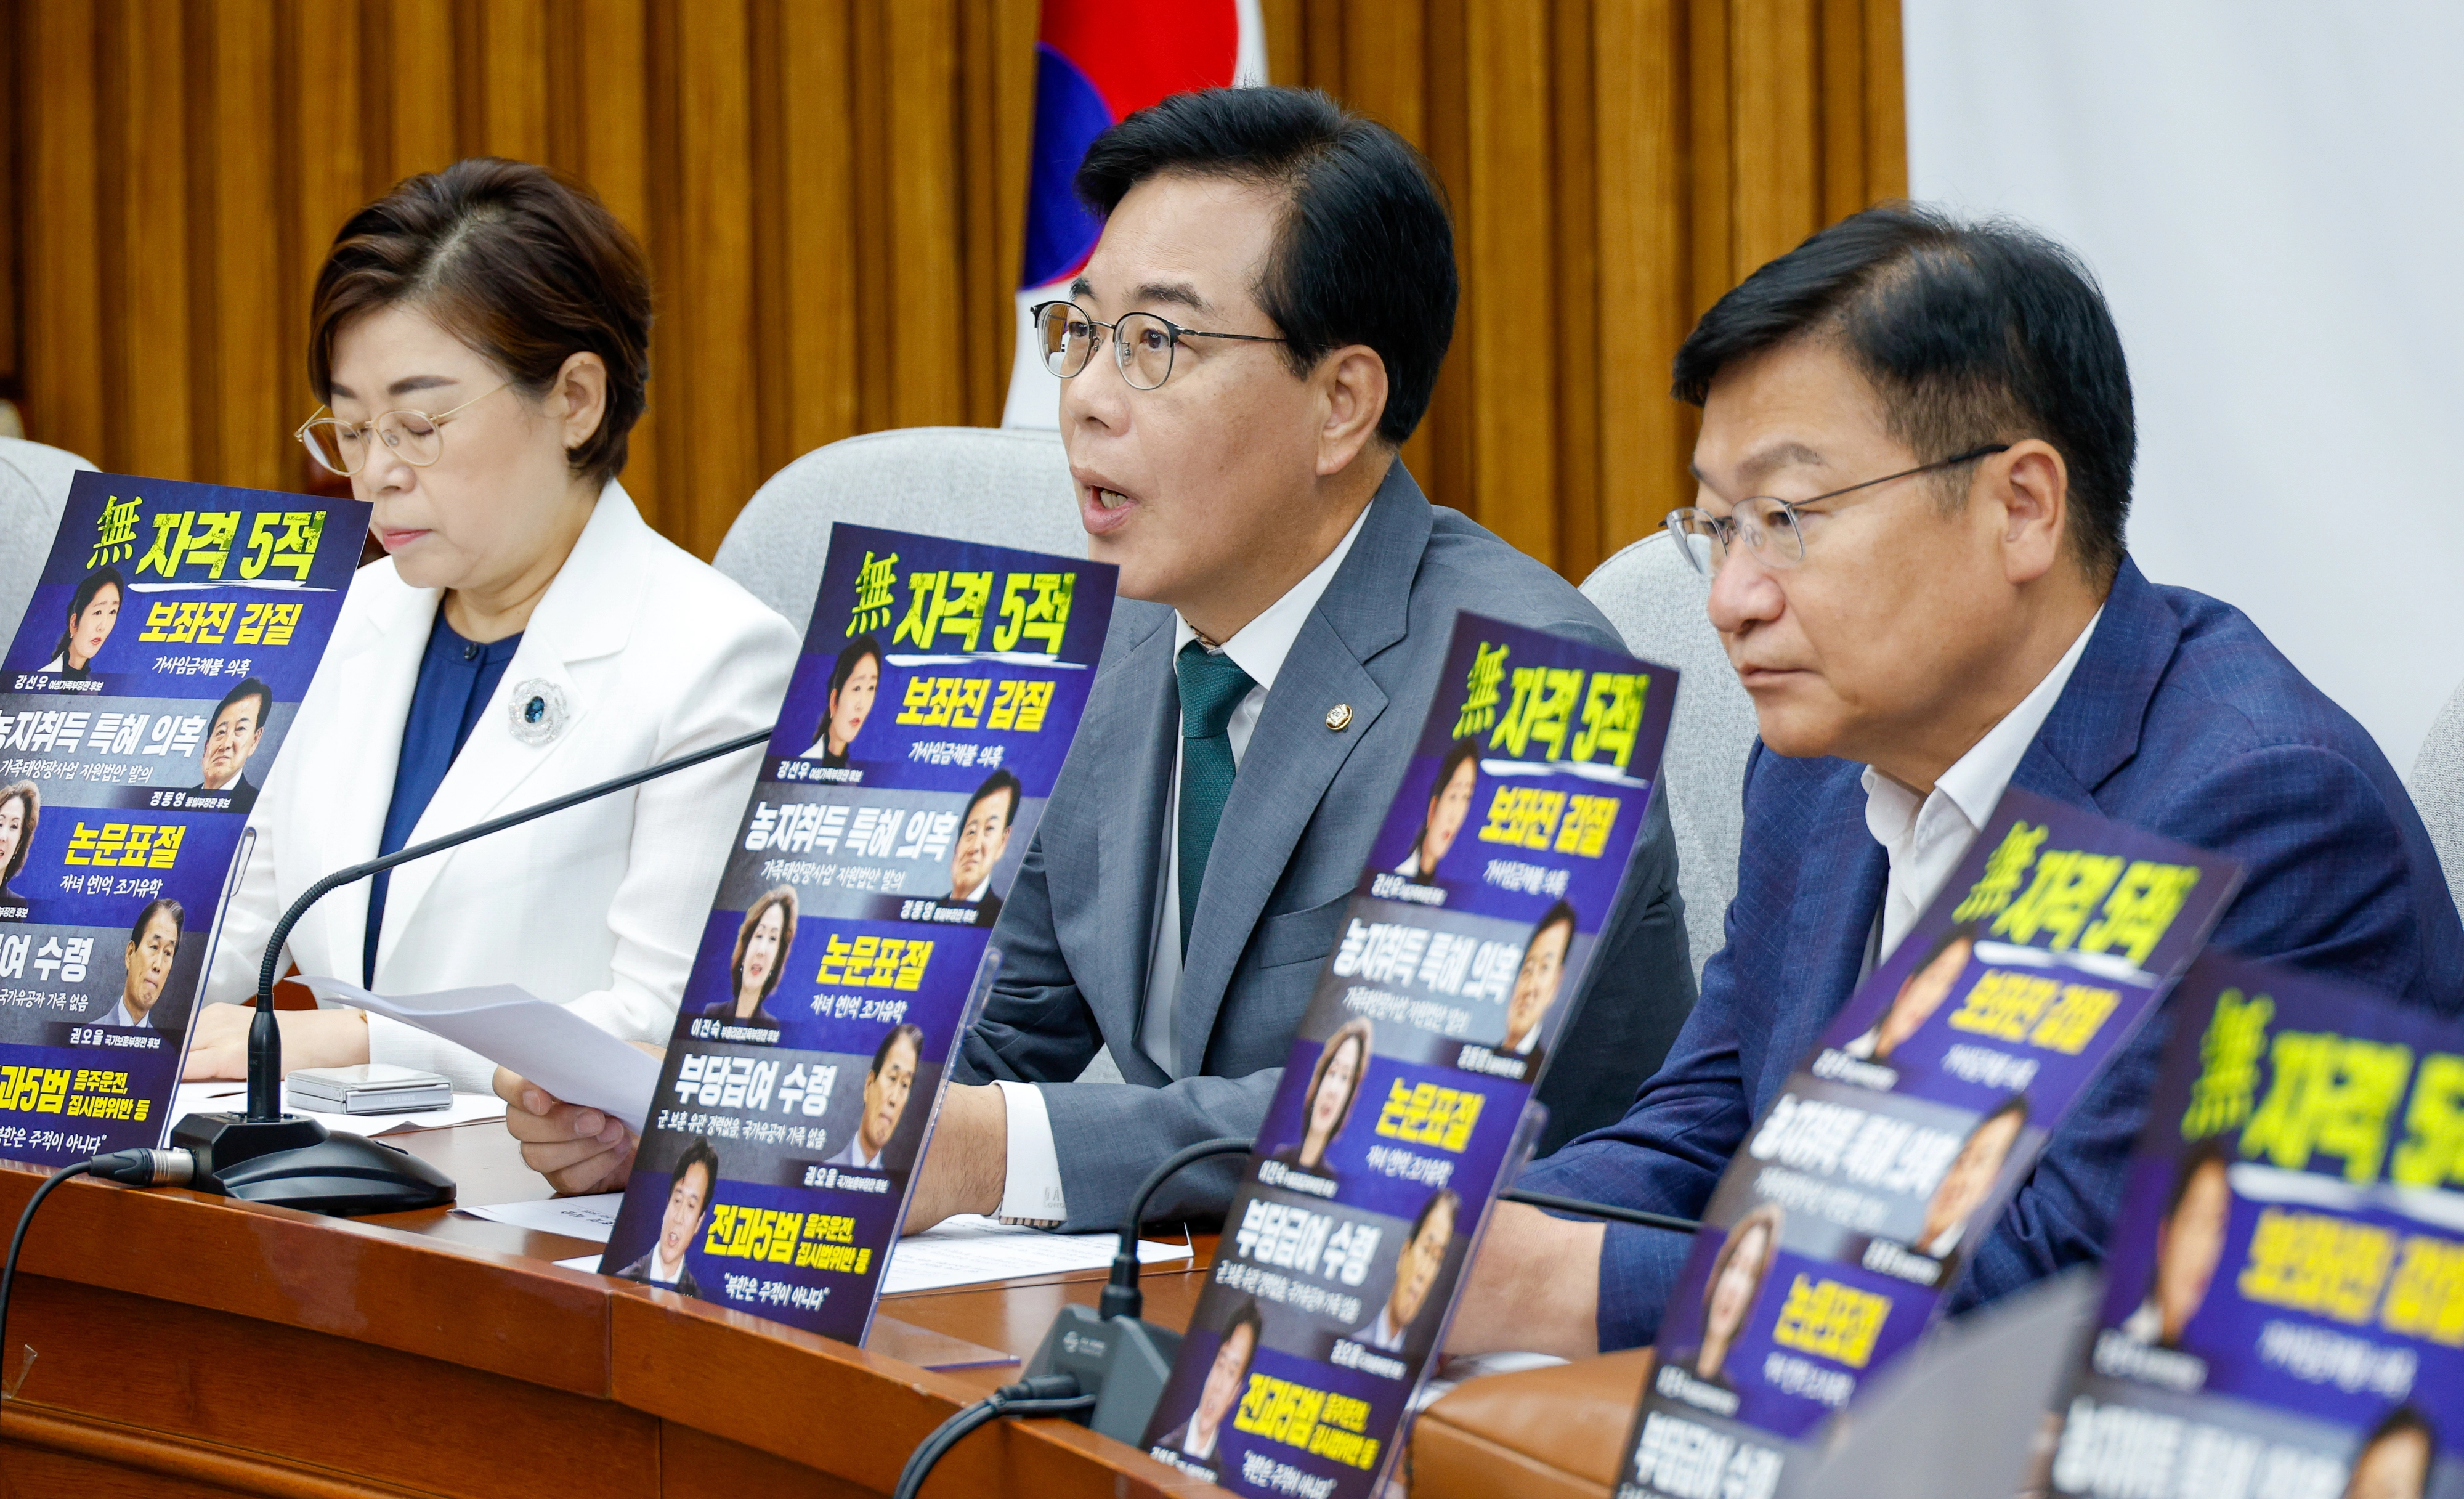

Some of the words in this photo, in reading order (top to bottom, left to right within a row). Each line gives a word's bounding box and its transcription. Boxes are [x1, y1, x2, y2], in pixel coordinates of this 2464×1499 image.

[86, 495, 144, 569] 無
[135, 511, 241, 578] 자격
[239, 511, 327, 580] 5적
[846, 550, 899, 638] 無
[892, 571, 993, 652] 자격
[992, 572, 1077, 654] 5적
[138, 601, 237, 644] 보좌진
[233, 603, 304, 646] 갑질
[152, 656, 224, 676] 가사임금체불
[224, 658, 251, 678] 의혹
[48, 680, 91, 691] 여성가족부장관
[89, 681, 104, 691] 후보
[895, 676, 991, 728] 보좌진
[986, 680, 1055, 732] 갑질
[1488, 666, 1585, 762] 자격
[1571, 672, 1651, 767] 5적
[87, 713, 150, 755] 특혜
[142, 715, 207, 757] 의혹
[1, 759, 79, 780] 가족태양광사업
[79, 762, 127, 782] 지원법안
[128, 765, 154, 784] 발의
[908, 741, 978, 767] 가사임금체불
[977, 744, 1005, 768] 의혹
[185, 797, 217, 808] 통일부장관
[216, 798, 232, 809] 후보
[63, 821, 187, 869] 논문표절
[744, 801, 850, 855] 농지취득
[845, 806, 908, 858] 특혜
[896, 808, 960, 863] 의혹
[60, 874, 84, 894] 자녀
[113, 878, 163, 899] 조기유학
[760, 859, 837, 888] 가족태양광사업
[836, 866, 881, 891] 지원법안
[881, 869, 906, 892] 발의
[0, 933, 31, 978] 여
[33, 936, 94, 983] 수령
[815, 933, 934, 992] 논문표절
[0, 988, 45, 1008] 국가유공자
[47, 992, 67, 1011] 가족
[69, 994, 89, 1012] 없음
[810, 993, 835, 1016] 자녀
[859, 999, 908, 1025] 조기유학
[105, 1034, 148, 1048] 국가보훈부장관
[147, 1038, 161, 1049] 후보
[0, 1065, 71, 1114] 과5범
[73, 1069, 129, 1094] 음주운전,
[674, 1053, 781, 1111] 부당급여
[777, 1063, 837, 1118] 수령
[67, 1095, 134, 1120] 집시법위반
[134, 1099, 151, 1121] 등
[28, 1130, 62, 1152] 주적이
[657, 1110, 668, 1130] 군
[742, 1119, 786, 1144] 국가유공자
[785, 1125, 806, 1147] 가족
[806, 1128, 827, 1150] 없음
[703, 1203, 804, 1264] 전과5범
[795, 1242, 857, 1272] 집시법위반
[854, 1248, 872, 1275] 등
[758, 1280, 793, 1307] 주적이
